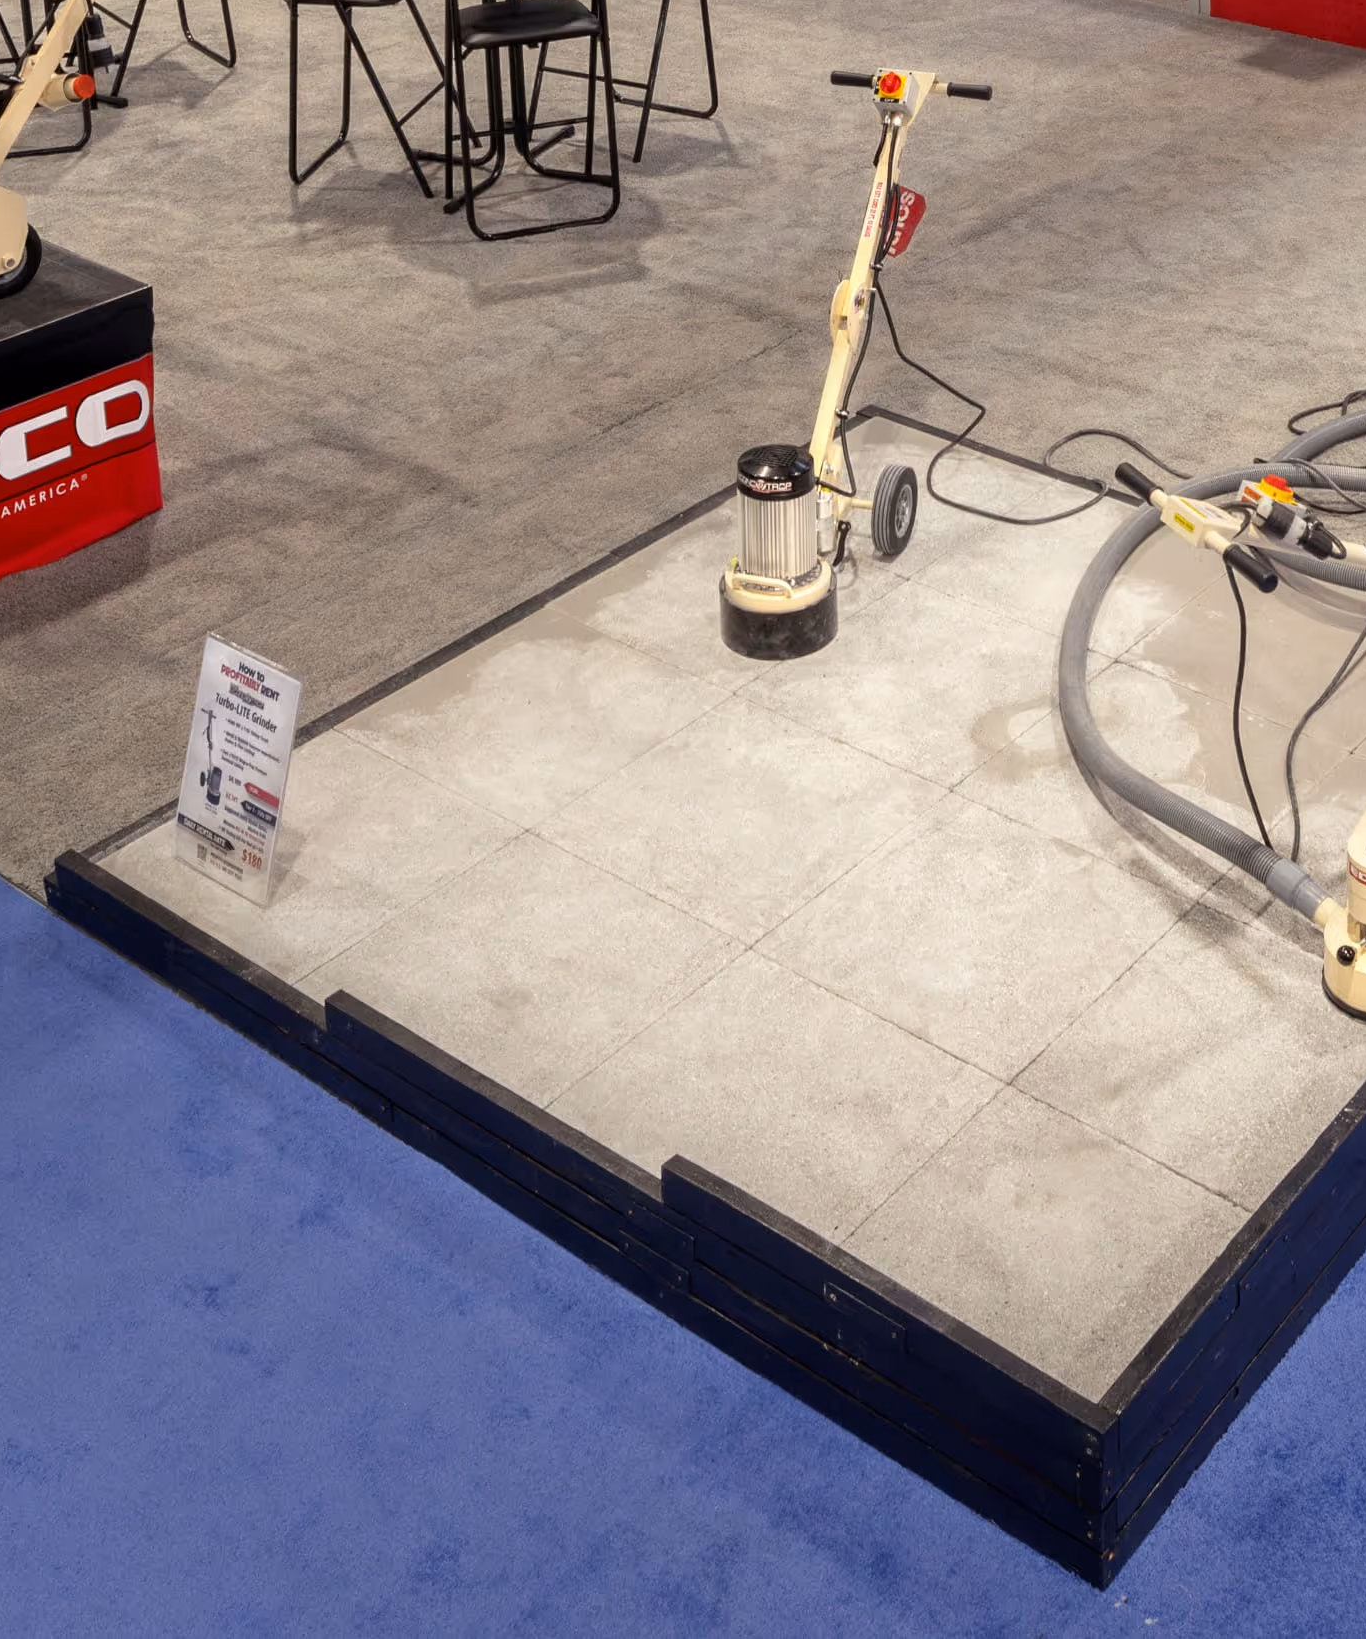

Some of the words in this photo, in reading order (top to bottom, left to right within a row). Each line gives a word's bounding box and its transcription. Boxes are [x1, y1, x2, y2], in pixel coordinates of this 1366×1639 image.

[0, 478, 80, 519] AMERICA
[216, 693, 251, 720] Turbo-LITE
[252, 712, 278, 733] Grinder
[242, 849, 263, 871] $180
